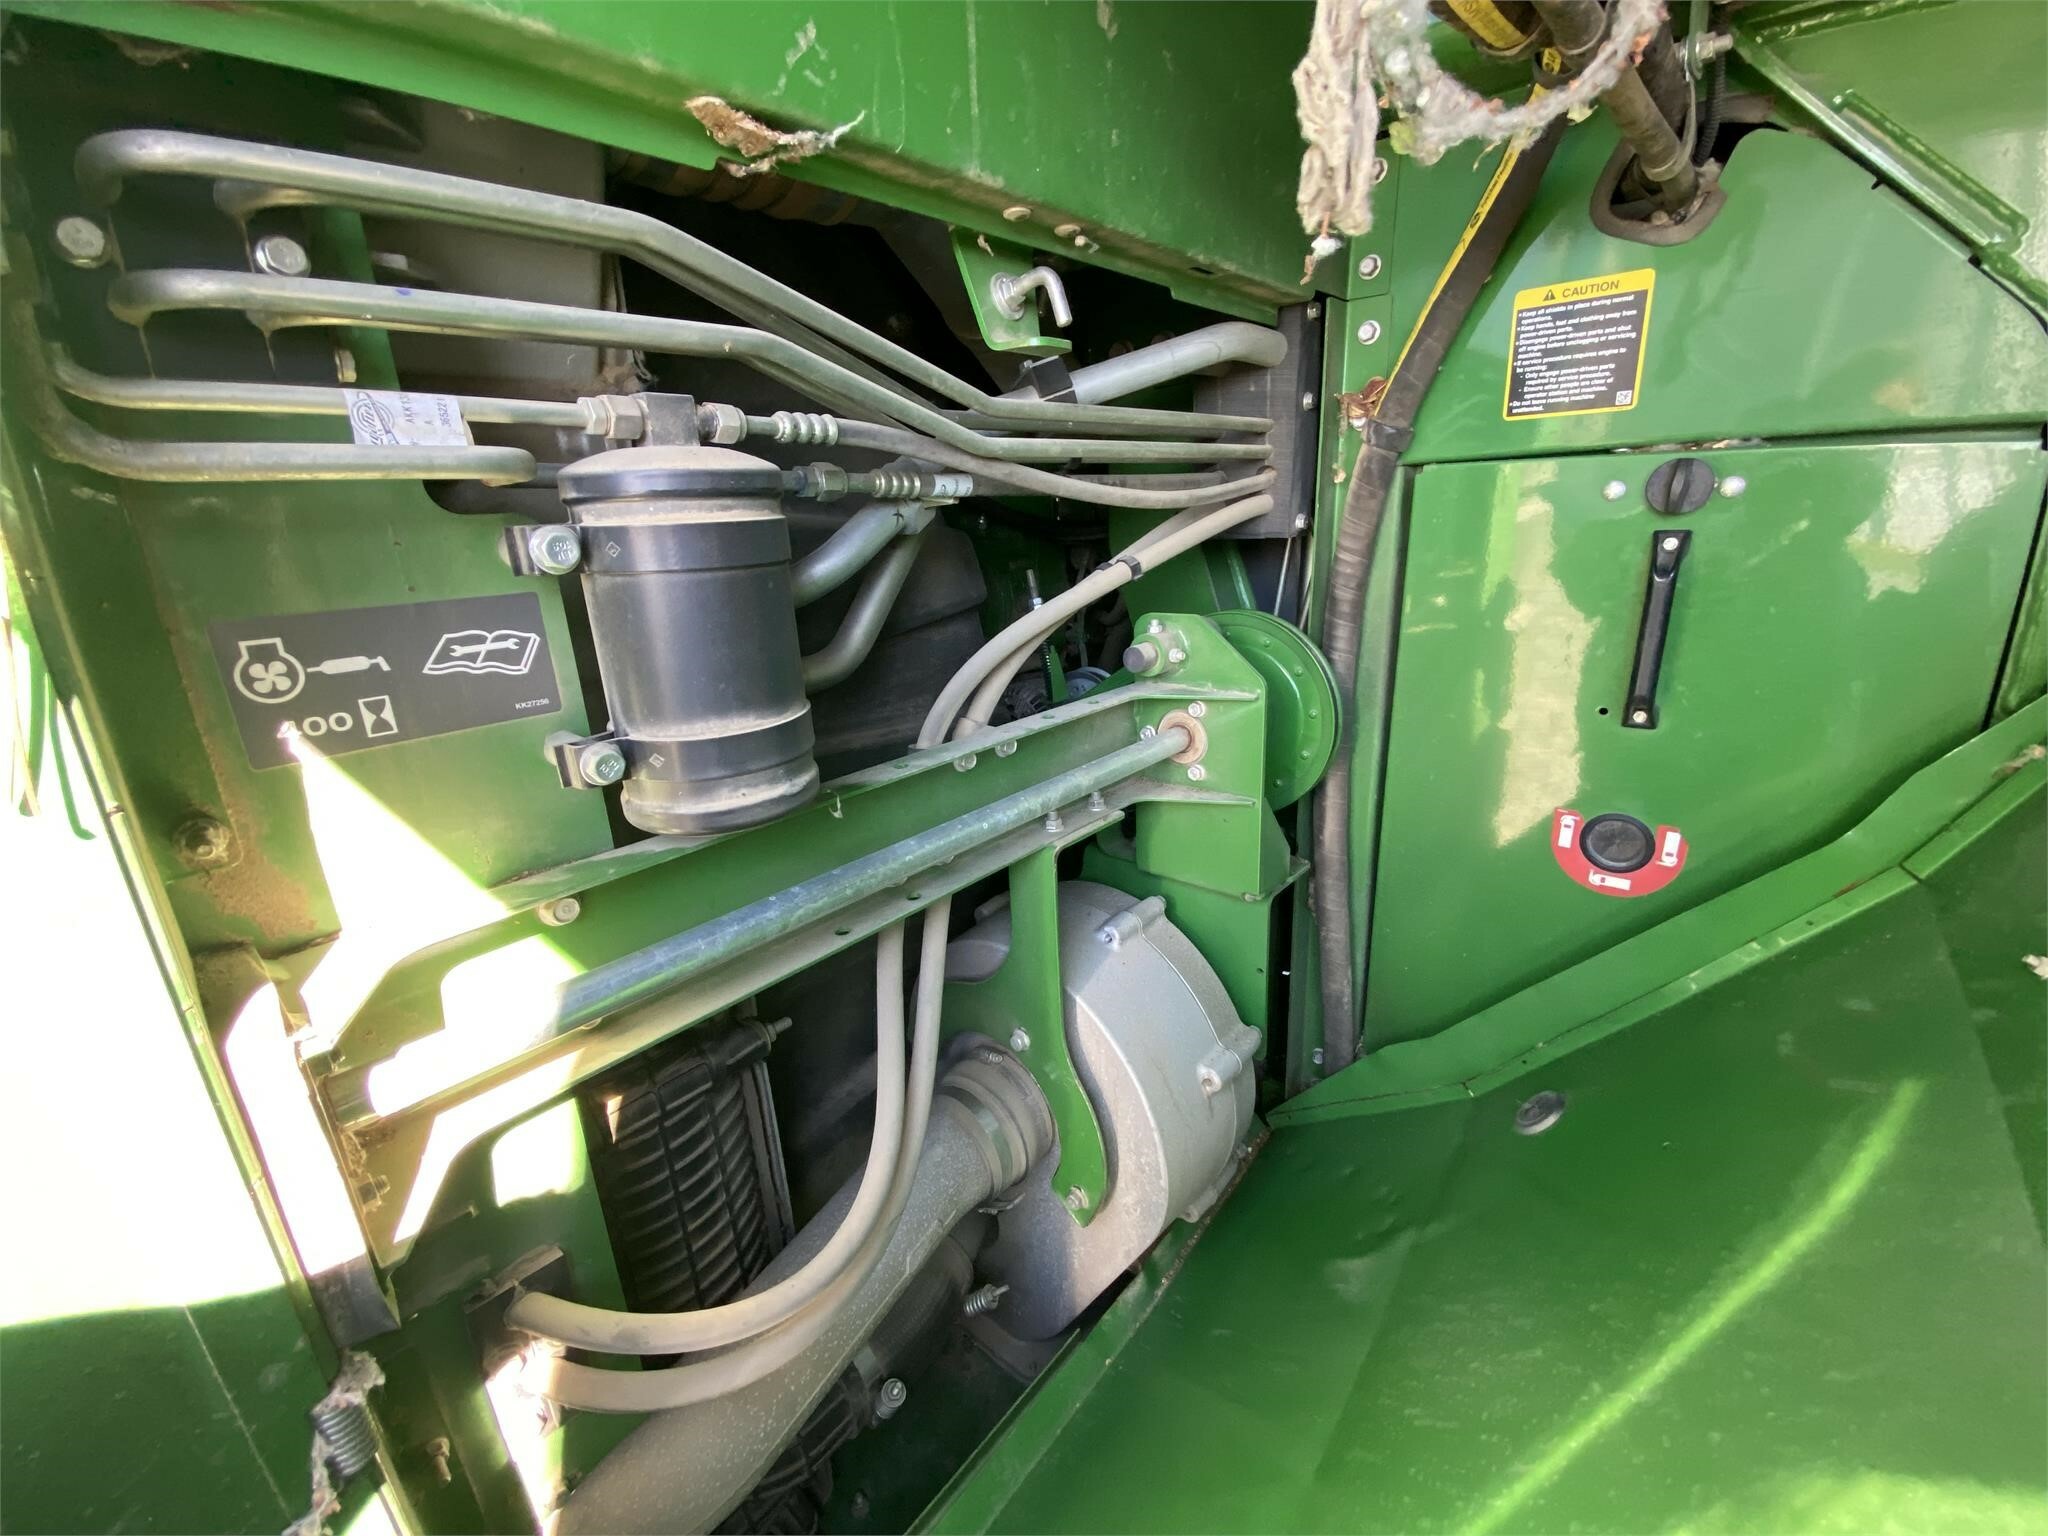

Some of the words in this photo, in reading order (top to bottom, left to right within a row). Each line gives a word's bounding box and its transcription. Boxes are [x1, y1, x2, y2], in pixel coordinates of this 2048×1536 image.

[1562, 280, 1620, 298] CAUTION
[1545, 306, 1566, 314] shields
[1574, 302, 1590, 310] place
[1612, 294, 1634, 303] normal
[1519, 329, 1556, 339] power-driven
[1519, 337, 1548, 345] Disengage
[1549, 332, 1586, 342] power-driven
[1608, 332, 1637, 340] servicing
[1542, 355, 1572, 364] procedure
[1572, 351, 1597, 359] requires
[1560, 366, 1599, 376] power-driven
[1560, 381, 1580, 389] people
